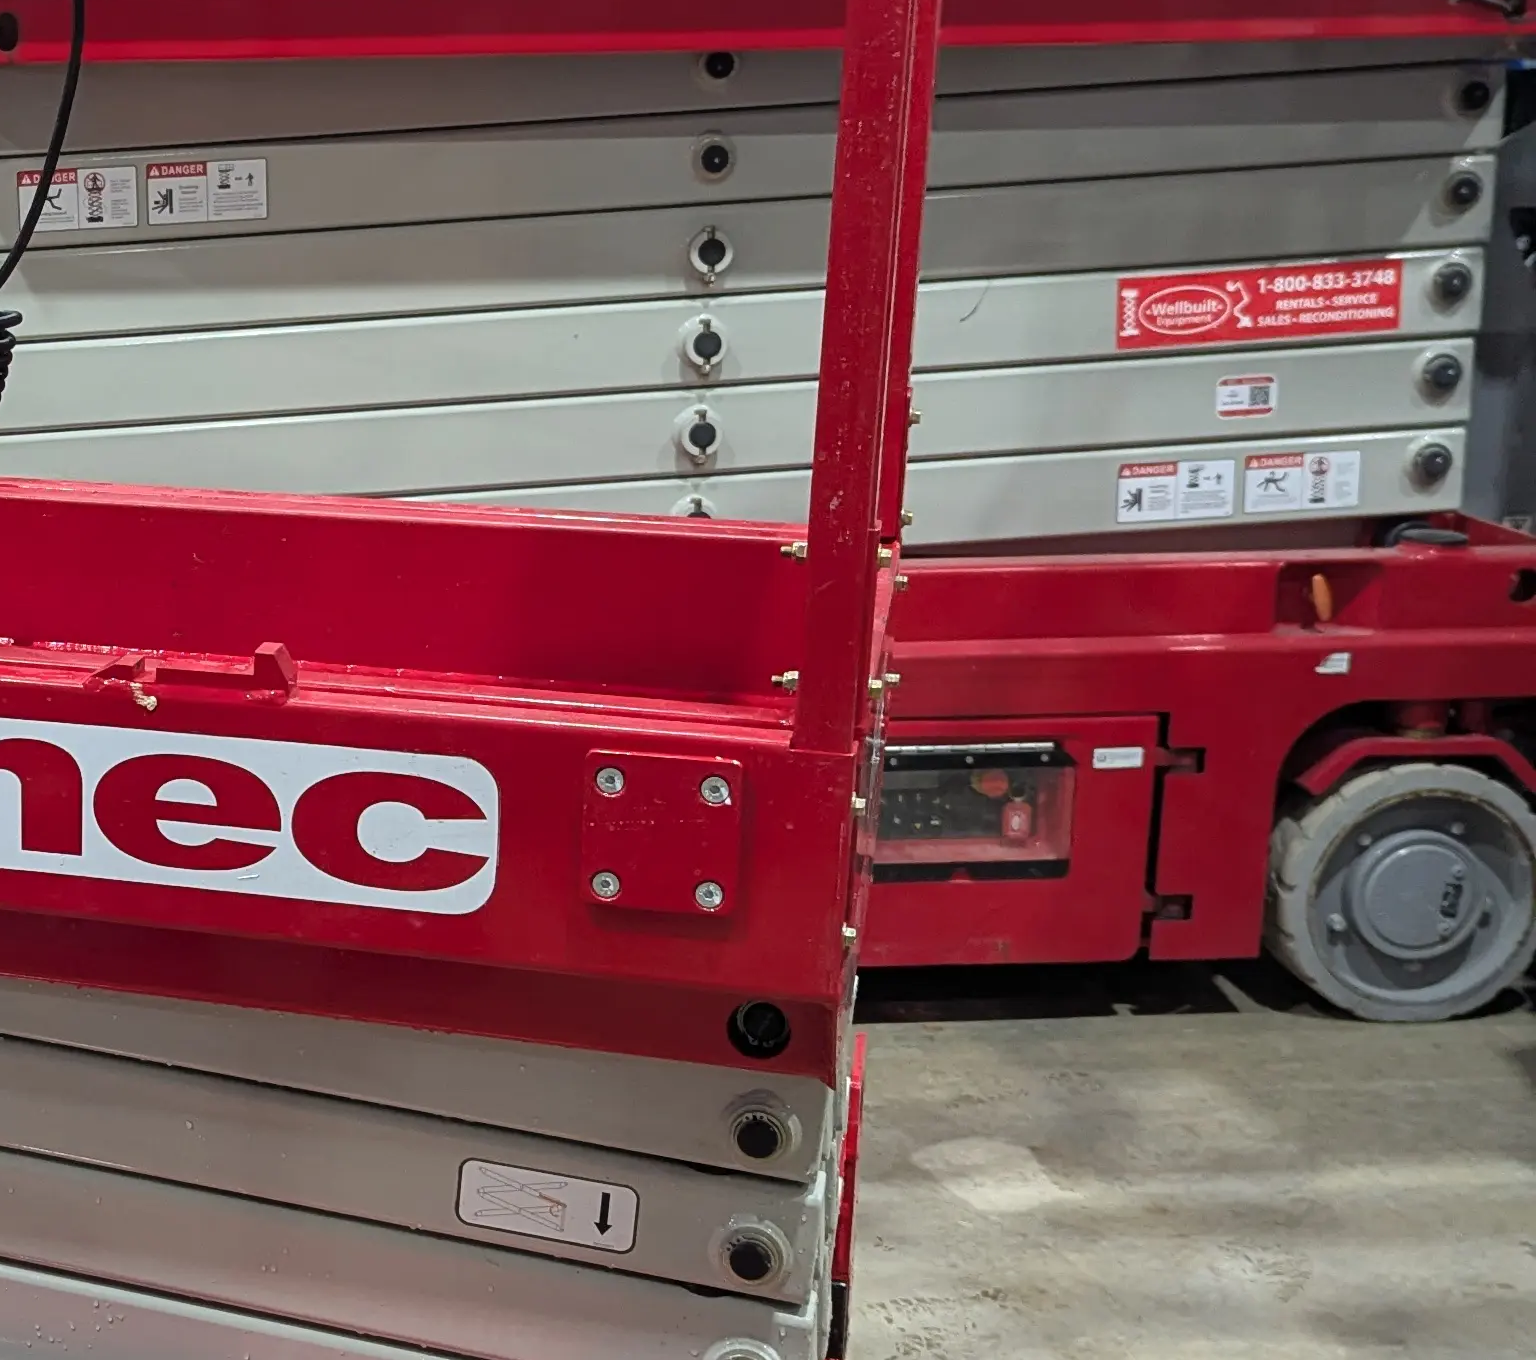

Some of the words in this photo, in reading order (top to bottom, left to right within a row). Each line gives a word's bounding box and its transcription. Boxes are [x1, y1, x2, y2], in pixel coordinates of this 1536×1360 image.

[161, 164, 204, 176] DANGER
[34, 172, 76, 184] DGER
[1257, 268, 1396, 294] 1-800-833-3748
[1151, 297, 1217, 316] Wellbuilt
[1276, 297, 1325, 311] RENTALS
[1332, 293, 1378, 306] SERVICE
[1156, 314, 1212, 327] Equipment
[1257, 314, 1292, 328] SALES
[1299, 307, 1395, 325] RECONDITIONING
[1259, 456, 1303, 467] DANGER
[1132, 464, 1175, 476] DANGER
